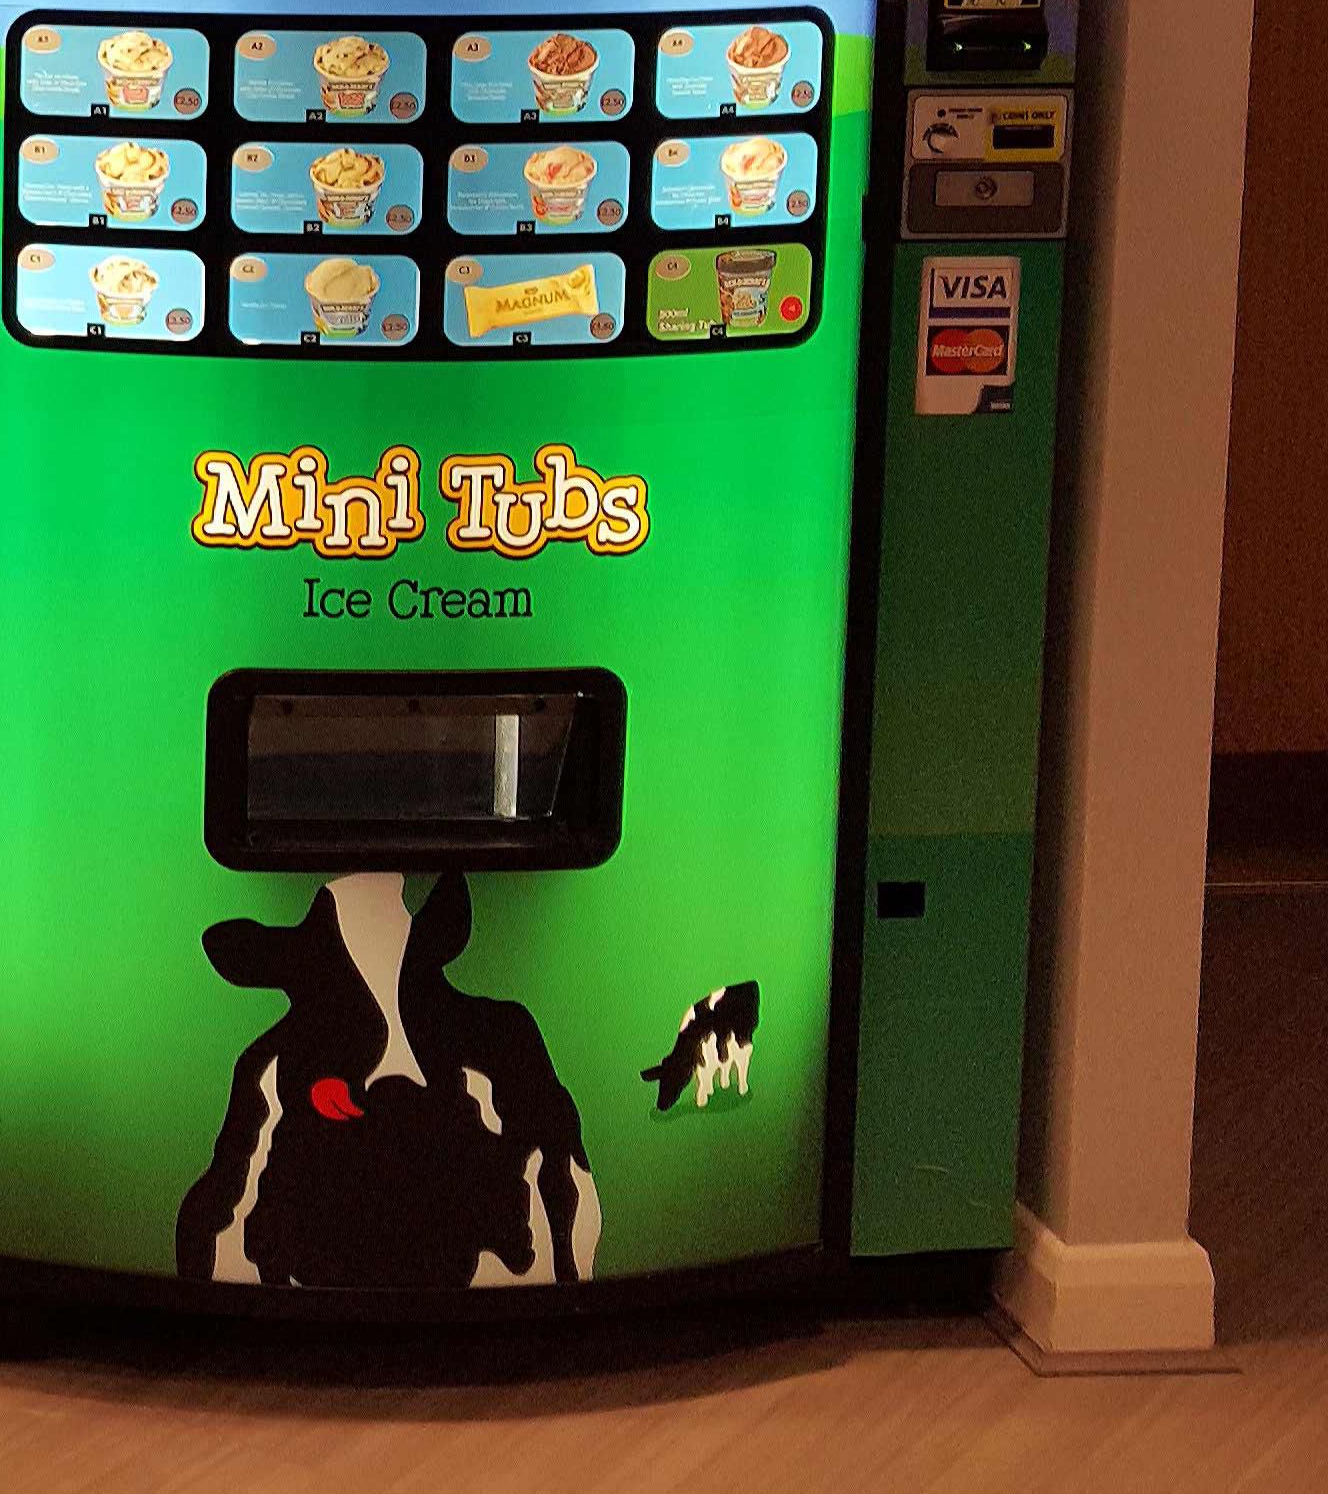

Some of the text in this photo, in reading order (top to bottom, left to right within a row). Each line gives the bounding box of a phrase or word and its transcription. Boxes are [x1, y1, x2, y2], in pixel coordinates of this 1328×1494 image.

[251, 42, 263, 51] A2
[93, 106, 107, 115] A1
[523, 112, 537, 120] A3
[721, 106, 735, 114] A4
[942, 275, 1008, 299] VISA
[495, 290, 571, 314] MAGNUM
[932, 343, 1004, 357] MasterCard
[197, 448, 646, 553] Mini Tubs
[302, 577, 533, 620] Ice Cream
